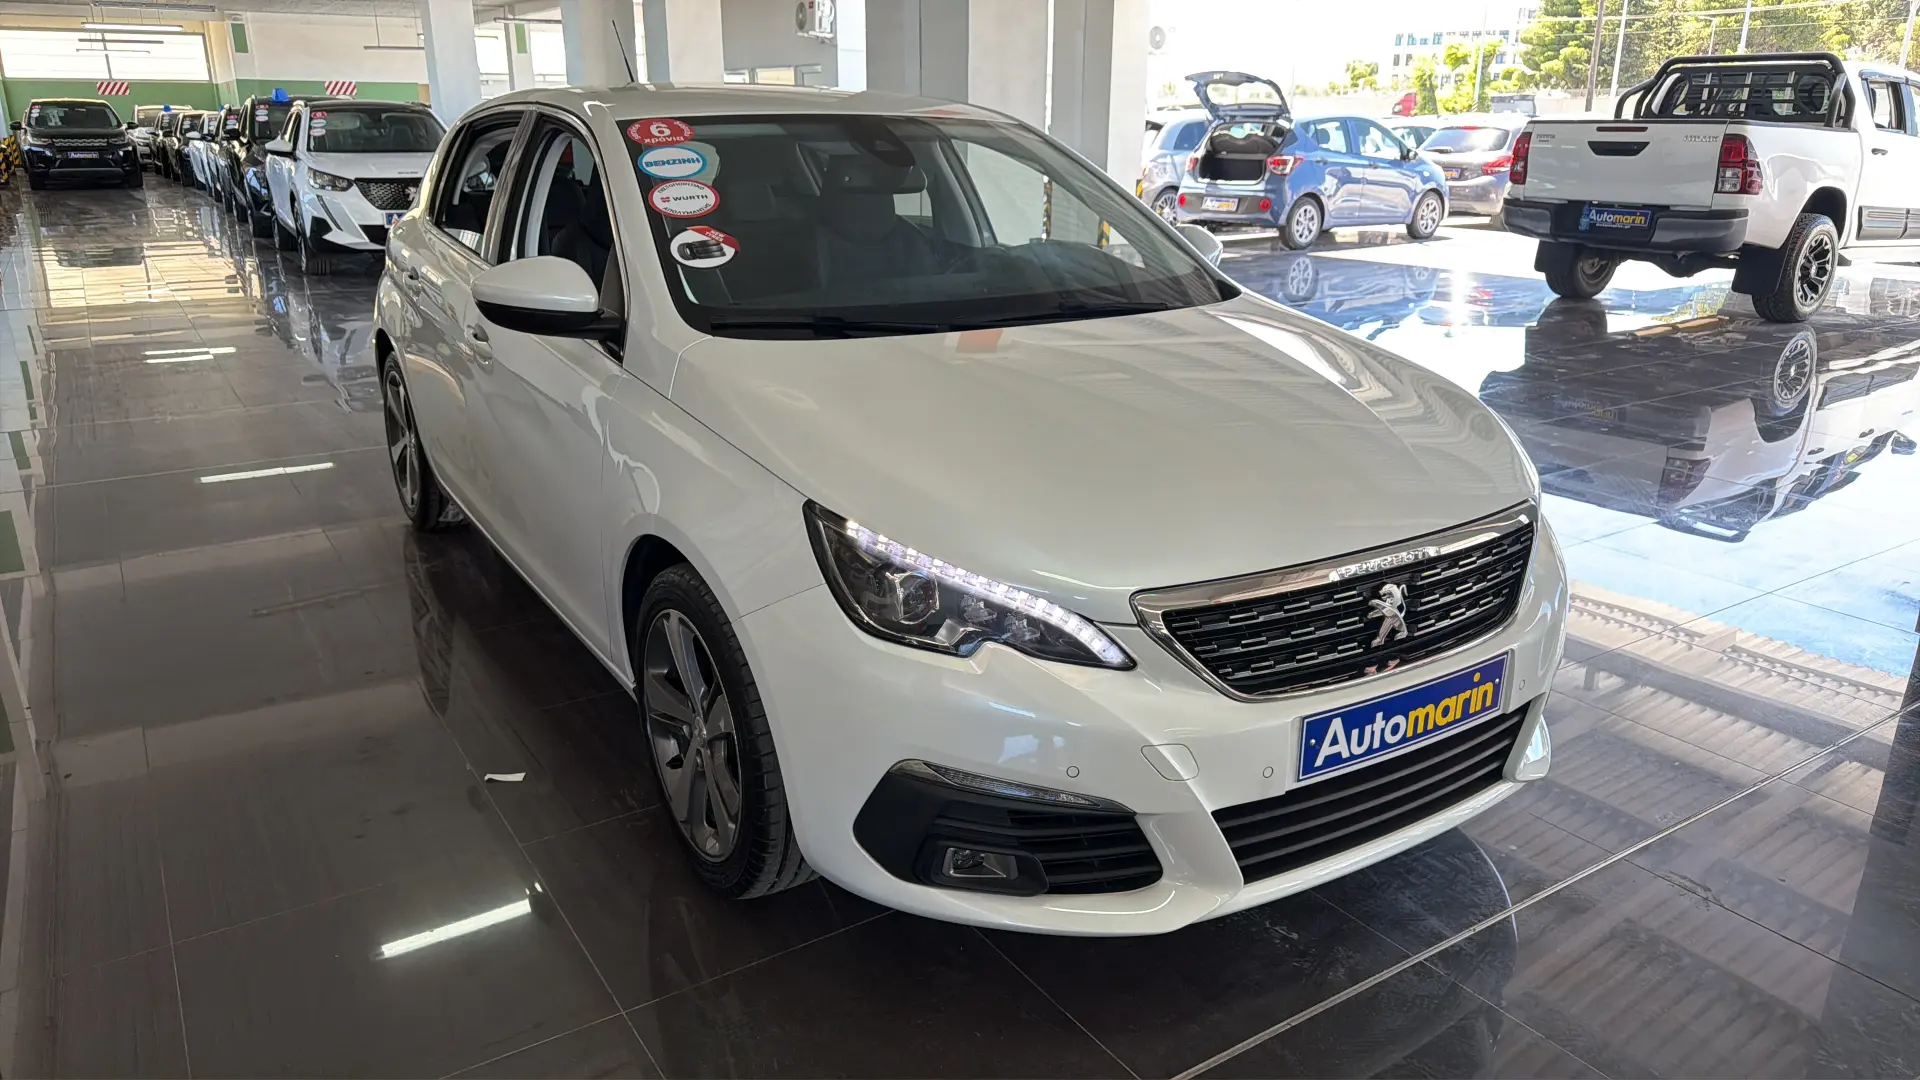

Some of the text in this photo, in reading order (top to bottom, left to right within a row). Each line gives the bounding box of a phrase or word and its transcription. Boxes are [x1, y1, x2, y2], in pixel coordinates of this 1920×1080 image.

[650, 123, 671, 137] 6
[1589, 209, 1646, 225] Automarin
[1313, 671, 1495, 768] Automarin
